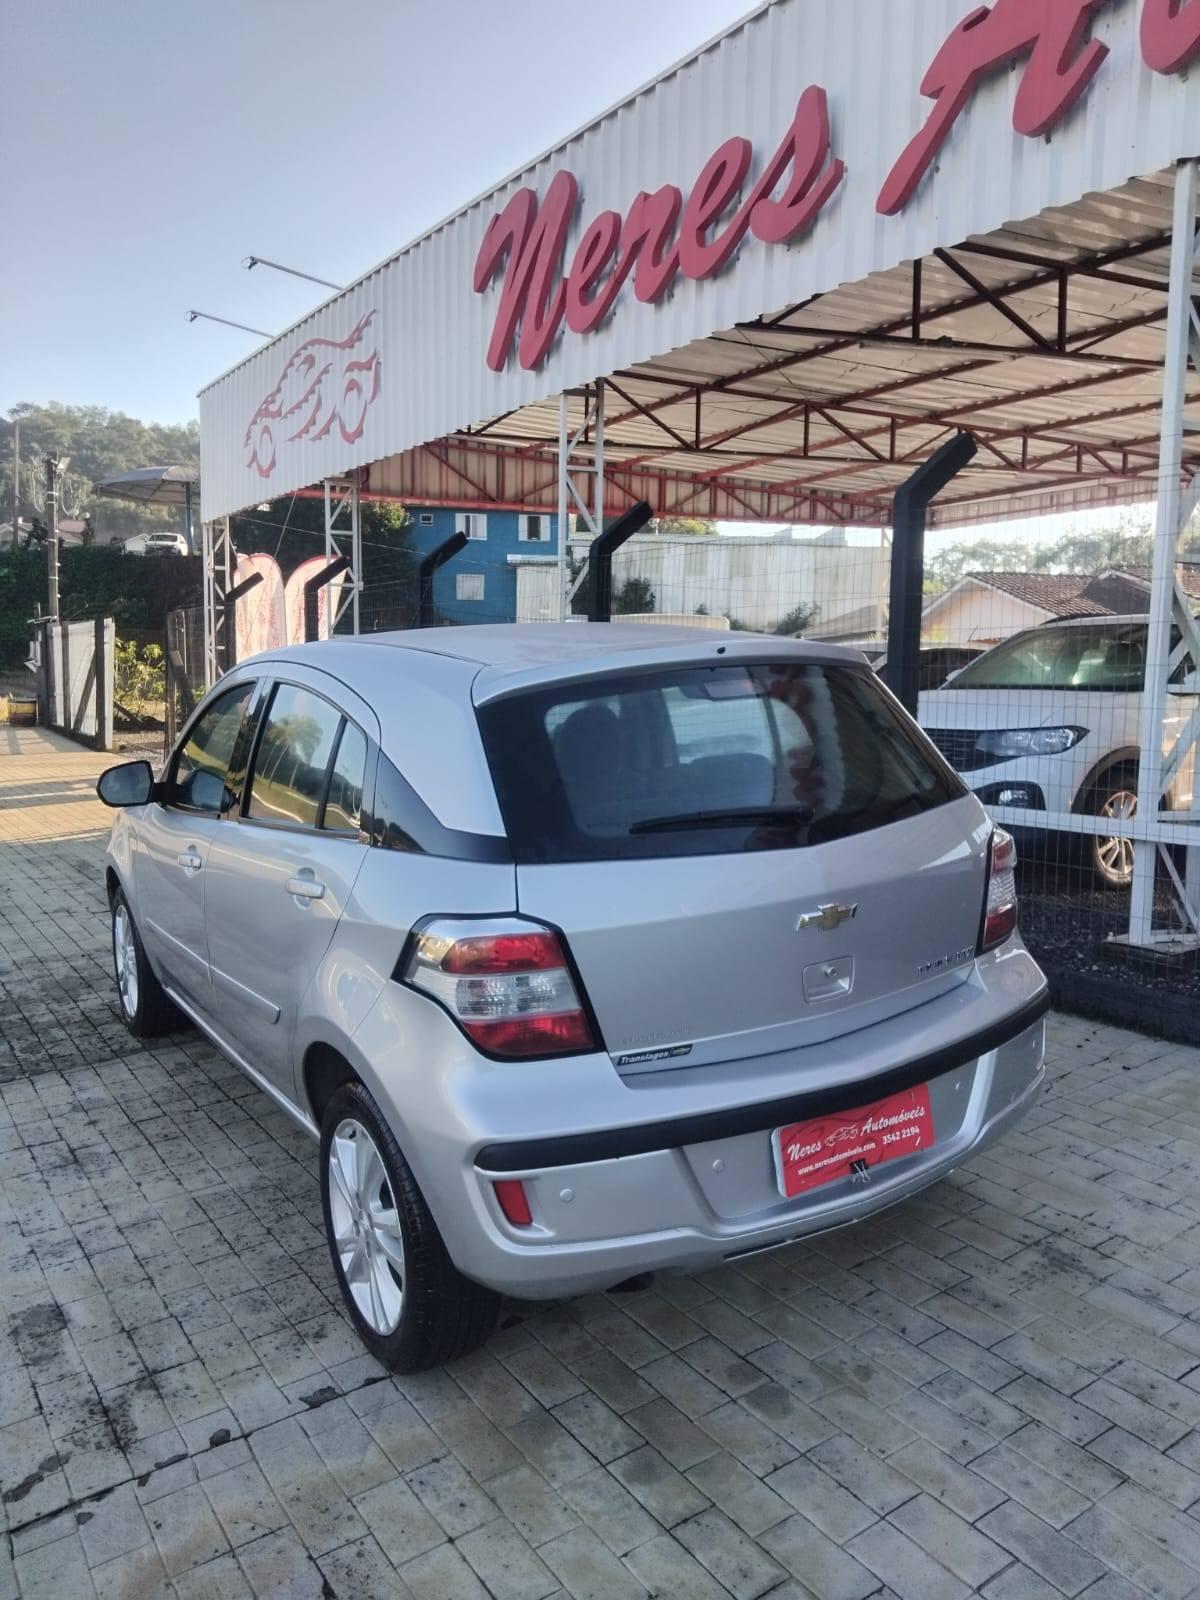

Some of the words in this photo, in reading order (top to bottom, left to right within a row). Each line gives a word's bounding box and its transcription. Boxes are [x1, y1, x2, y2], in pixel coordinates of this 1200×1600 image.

[473, 84, 846, 373] Neres
[787, 1139, 822, 1161] Neres
[860, 1106, 926, 1137] Automóveis
[882, 1131, 901, 1146] 3542
